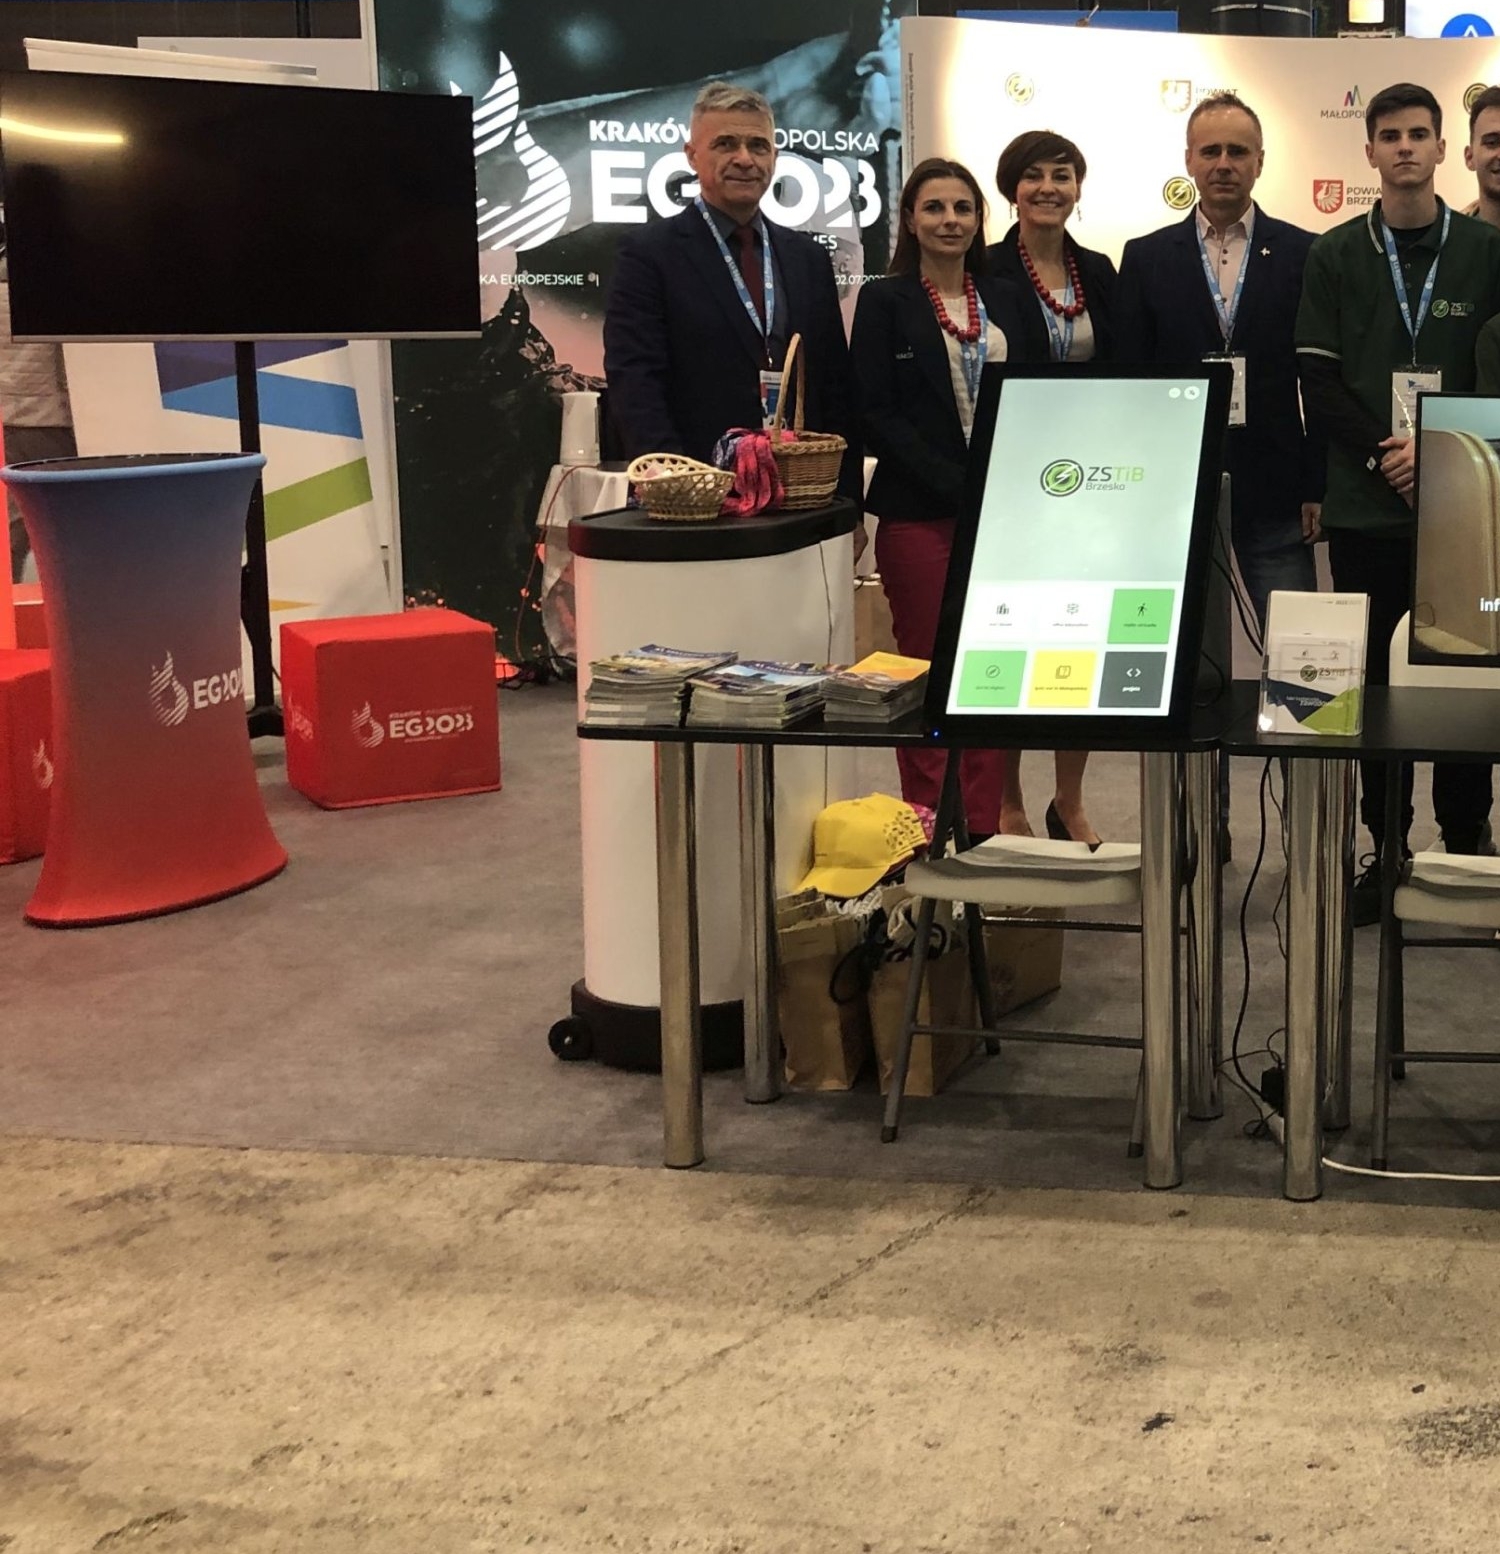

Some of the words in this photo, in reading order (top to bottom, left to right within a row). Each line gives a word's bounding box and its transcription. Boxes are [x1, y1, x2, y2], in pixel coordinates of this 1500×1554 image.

[774, 127, 880, 153] OPOLSKA
[500, 273, 585, 286] EUROPEJSKIE
[1085, 482, 1126, 491] Brzesko
[389, 713, 474, 738] EG2023
